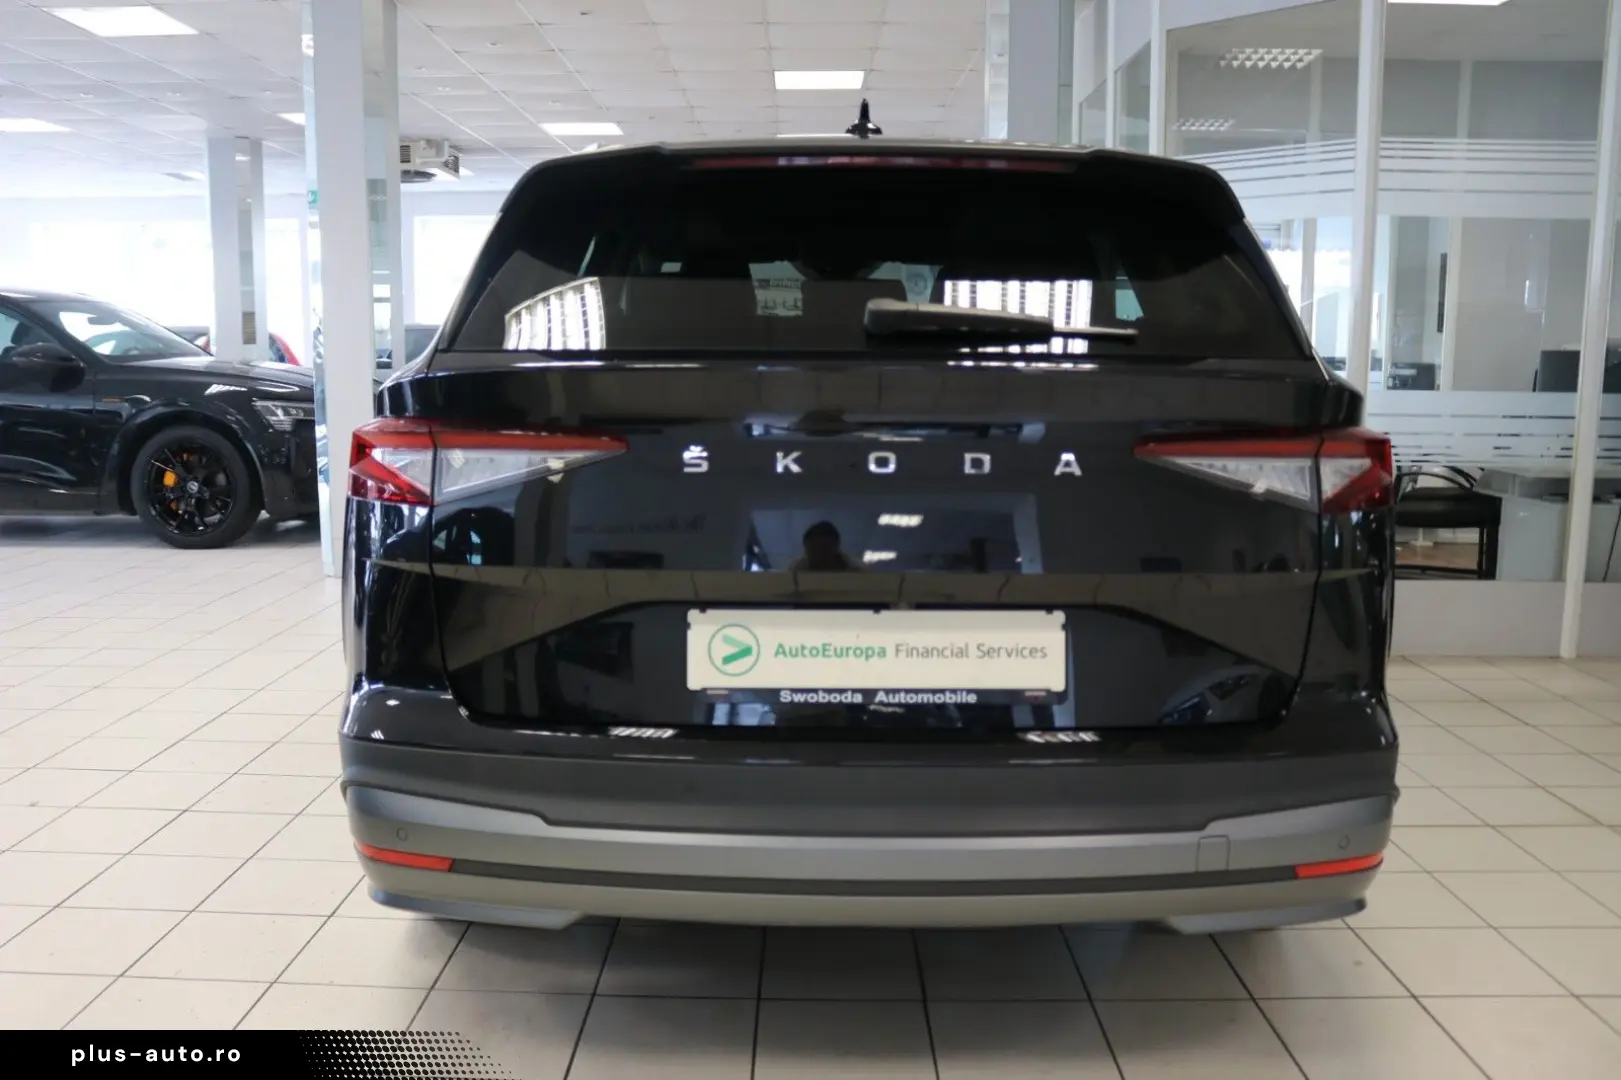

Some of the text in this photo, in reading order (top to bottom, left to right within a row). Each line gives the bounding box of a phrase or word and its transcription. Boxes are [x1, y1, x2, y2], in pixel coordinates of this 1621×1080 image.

[682, 445, 1082, 477] ŠKODA
[773, 641, 1049, 661] AutoEuropa Financial Services
[778, 689, 978, 705] Swoboda Automobile
